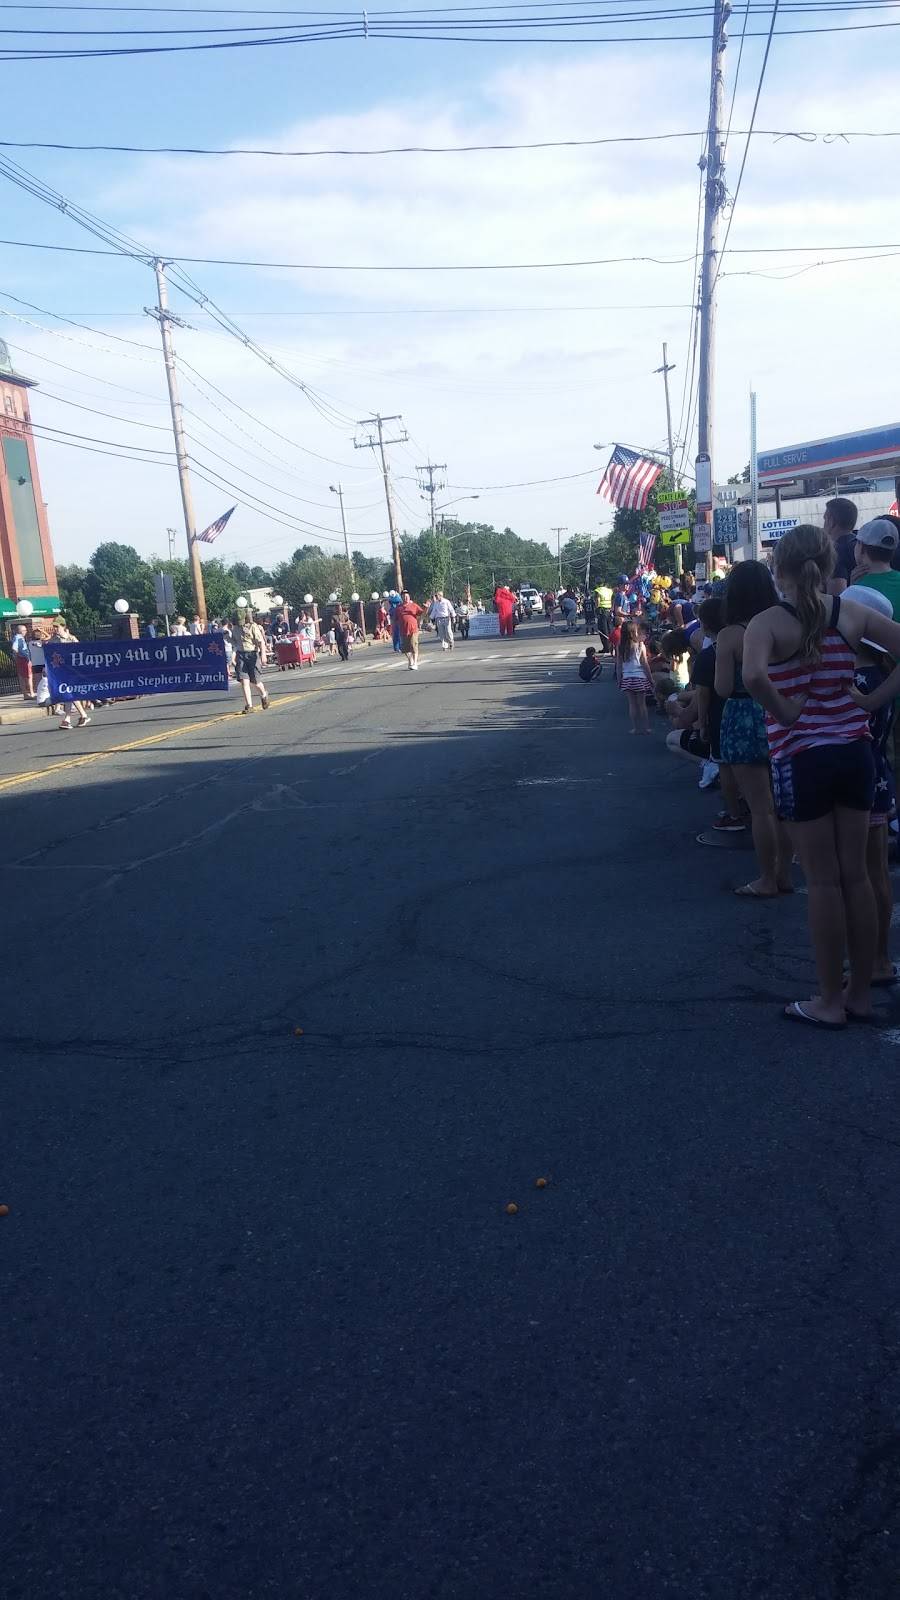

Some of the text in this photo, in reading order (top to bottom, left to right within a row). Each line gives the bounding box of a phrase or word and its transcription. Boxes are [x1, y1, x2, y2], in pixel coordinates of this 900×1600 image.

[764, 451, 808, 468] FULL SERVE
[663, 501, 682, 511] STOP
[762, 519, 797, 529] LOTTERY
[769, 530, 787, 539] KEN
[71, 644, 204, 668] Happy 4th of July
[58, 670, 226, 694] Congressman Stephen F. Lynch
